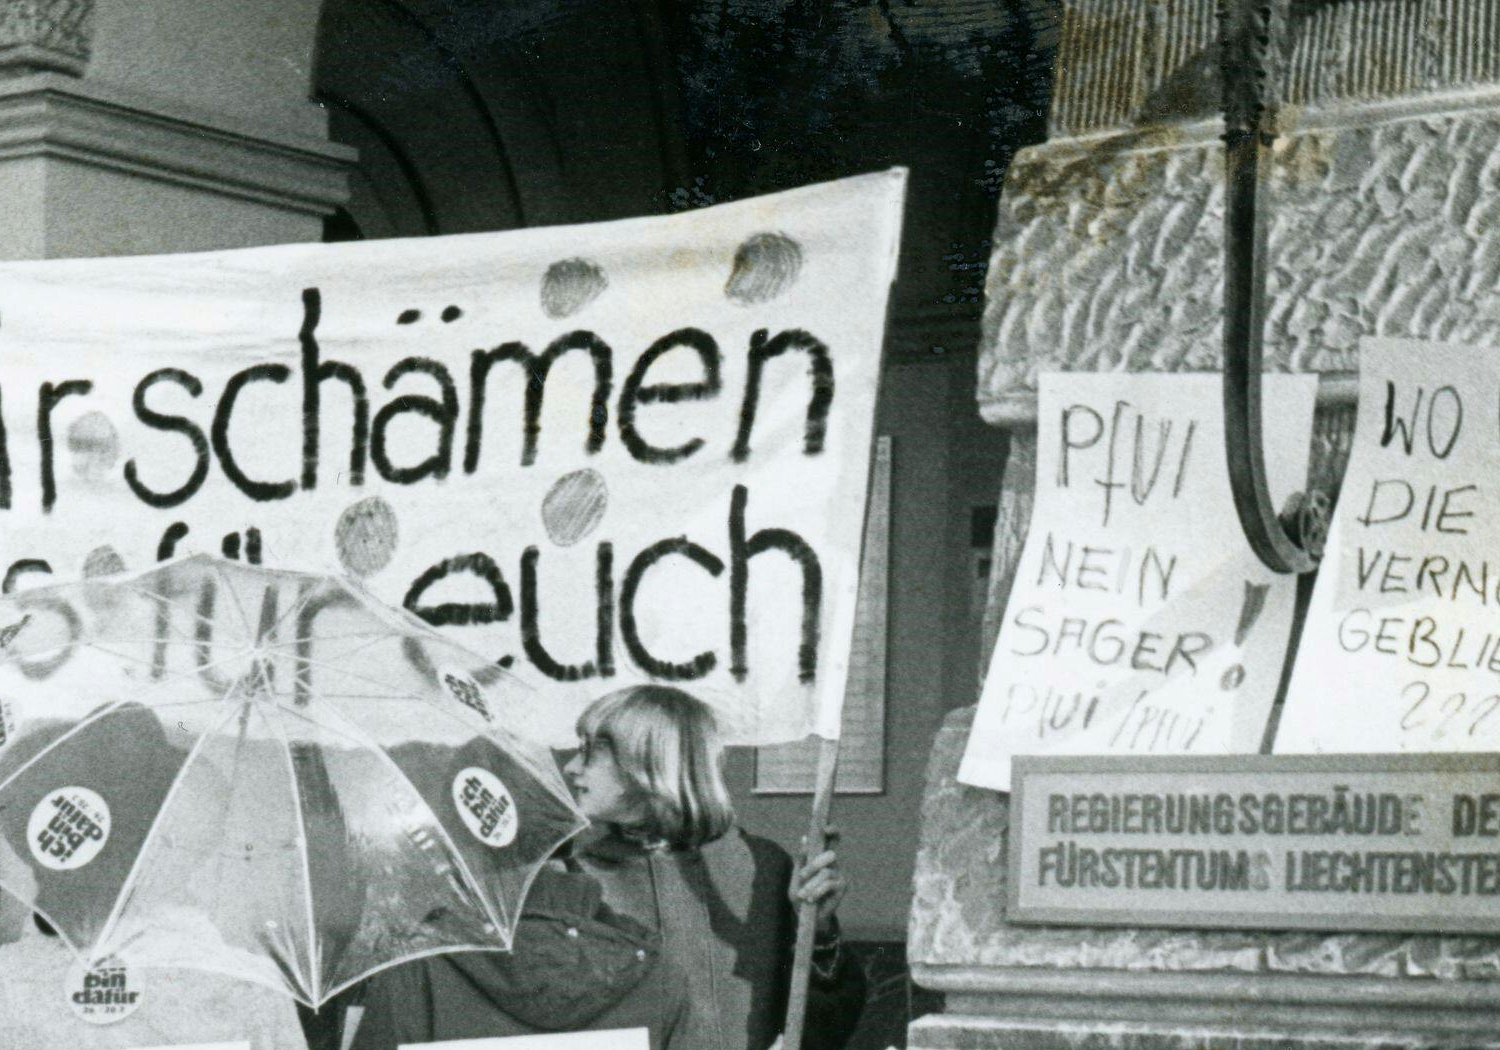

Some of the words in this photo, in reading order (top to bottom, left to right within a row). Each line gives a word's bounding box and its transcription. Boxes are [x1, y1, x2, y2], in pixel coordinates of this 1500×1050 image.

[122, 288, 837, 509] schämen
[1380, 379, 1464, 460] WO
[1356, 478, 1478, 535] DIE
[401, 484, 824, 684] euch
[1036, 531, 1178, 607] NEIN
[1357, 546, 1500, 606] VERN
[1452, 793, 1500, 837] DE
[1037, 841, 1270, 890] FÜRSTENTUMS
